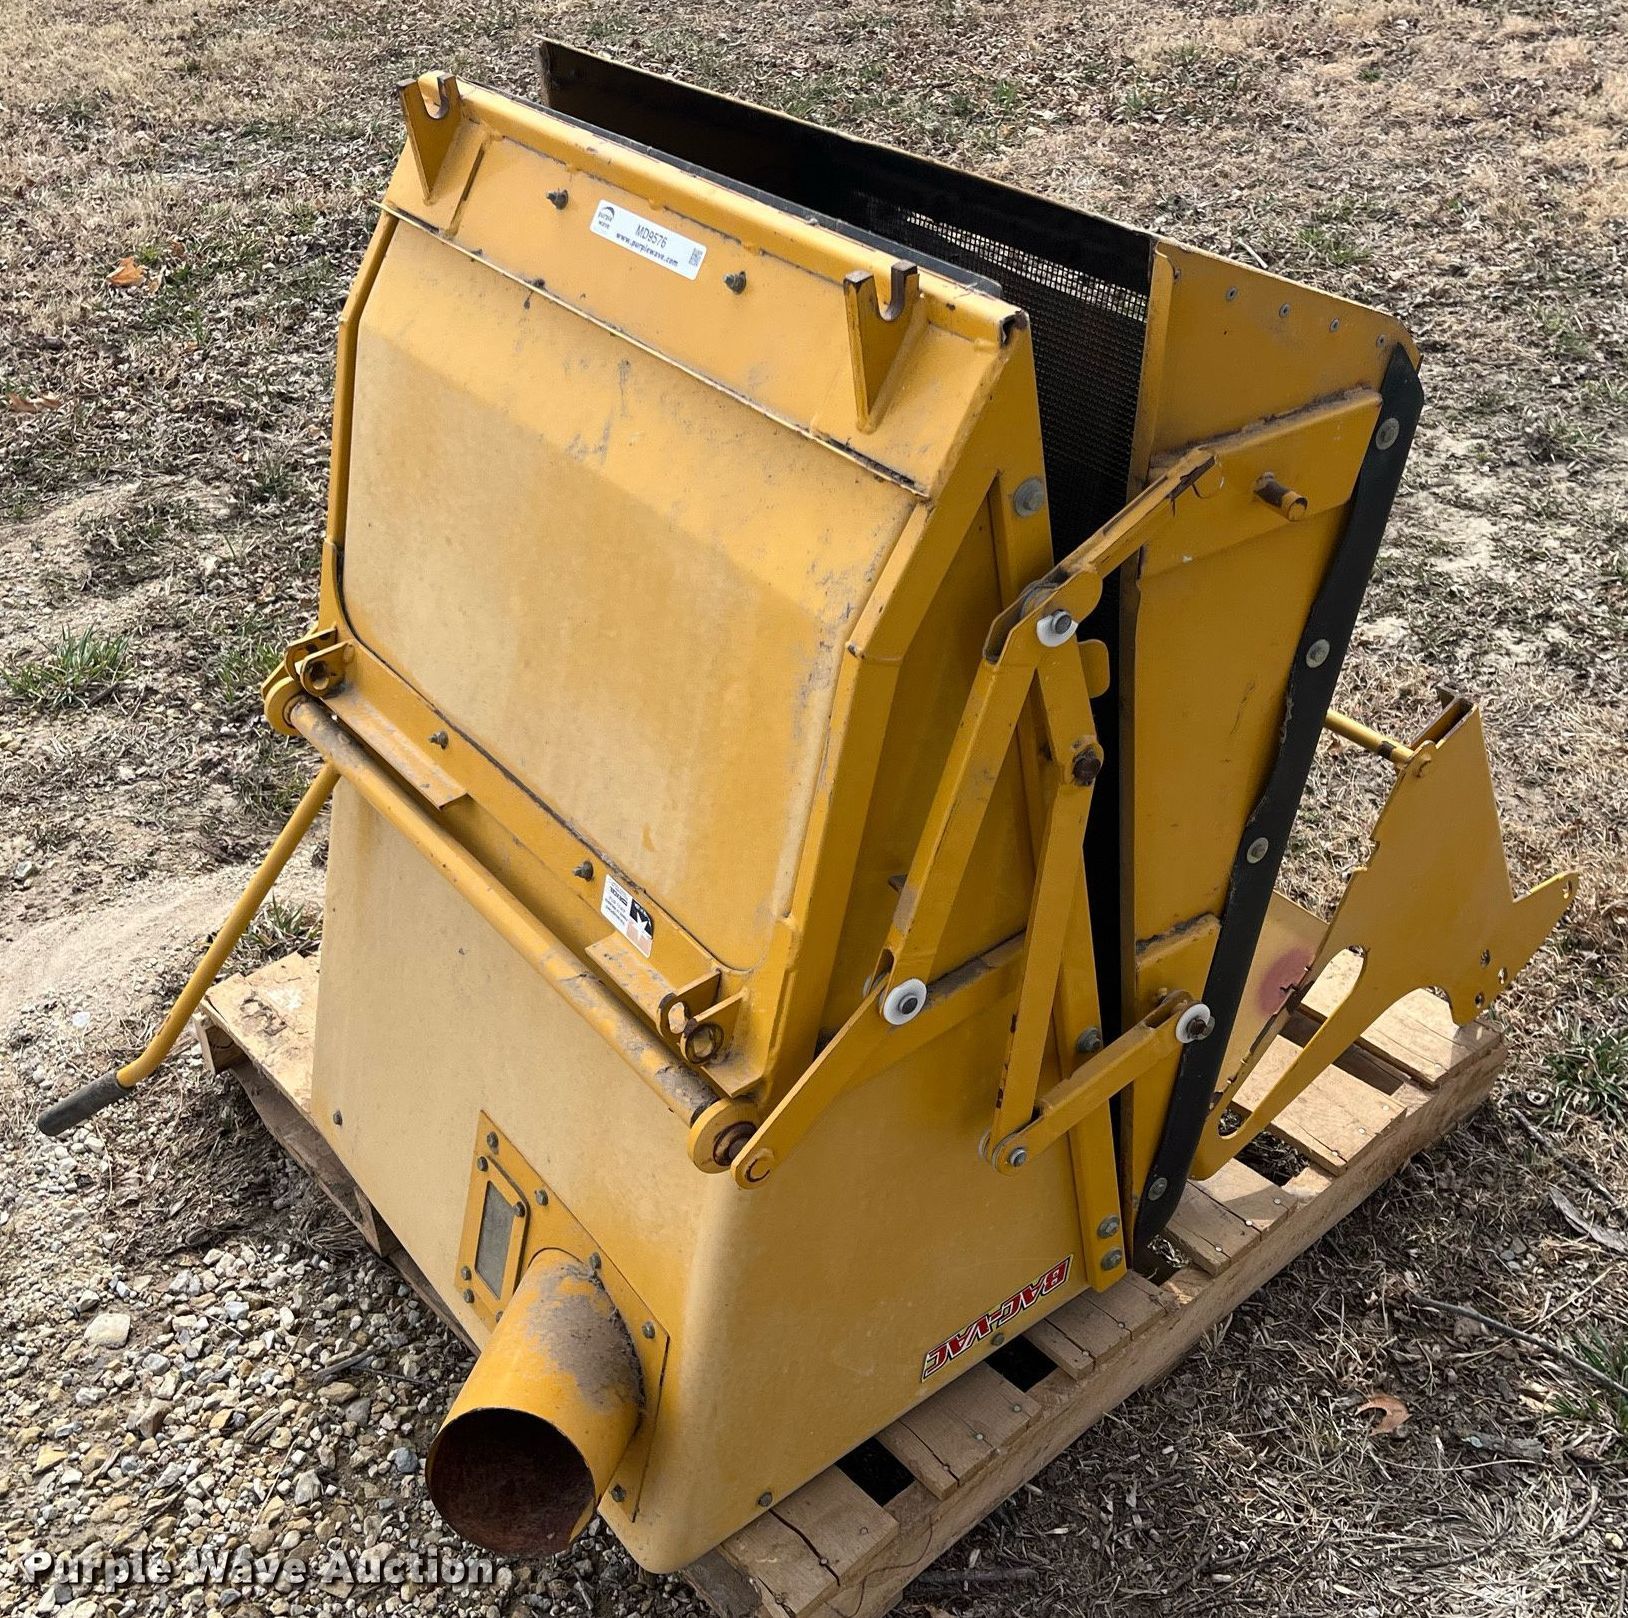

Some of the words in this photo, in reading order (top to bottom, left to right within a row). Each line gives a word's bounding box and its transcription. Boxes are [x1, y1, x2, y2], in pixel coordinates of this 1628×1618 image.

[616, 232, 679, 267] www.purplewave.com
[635, 225, 668, 249] MD9576
[923, 1257, 1071, 1380] BAC-VAC
